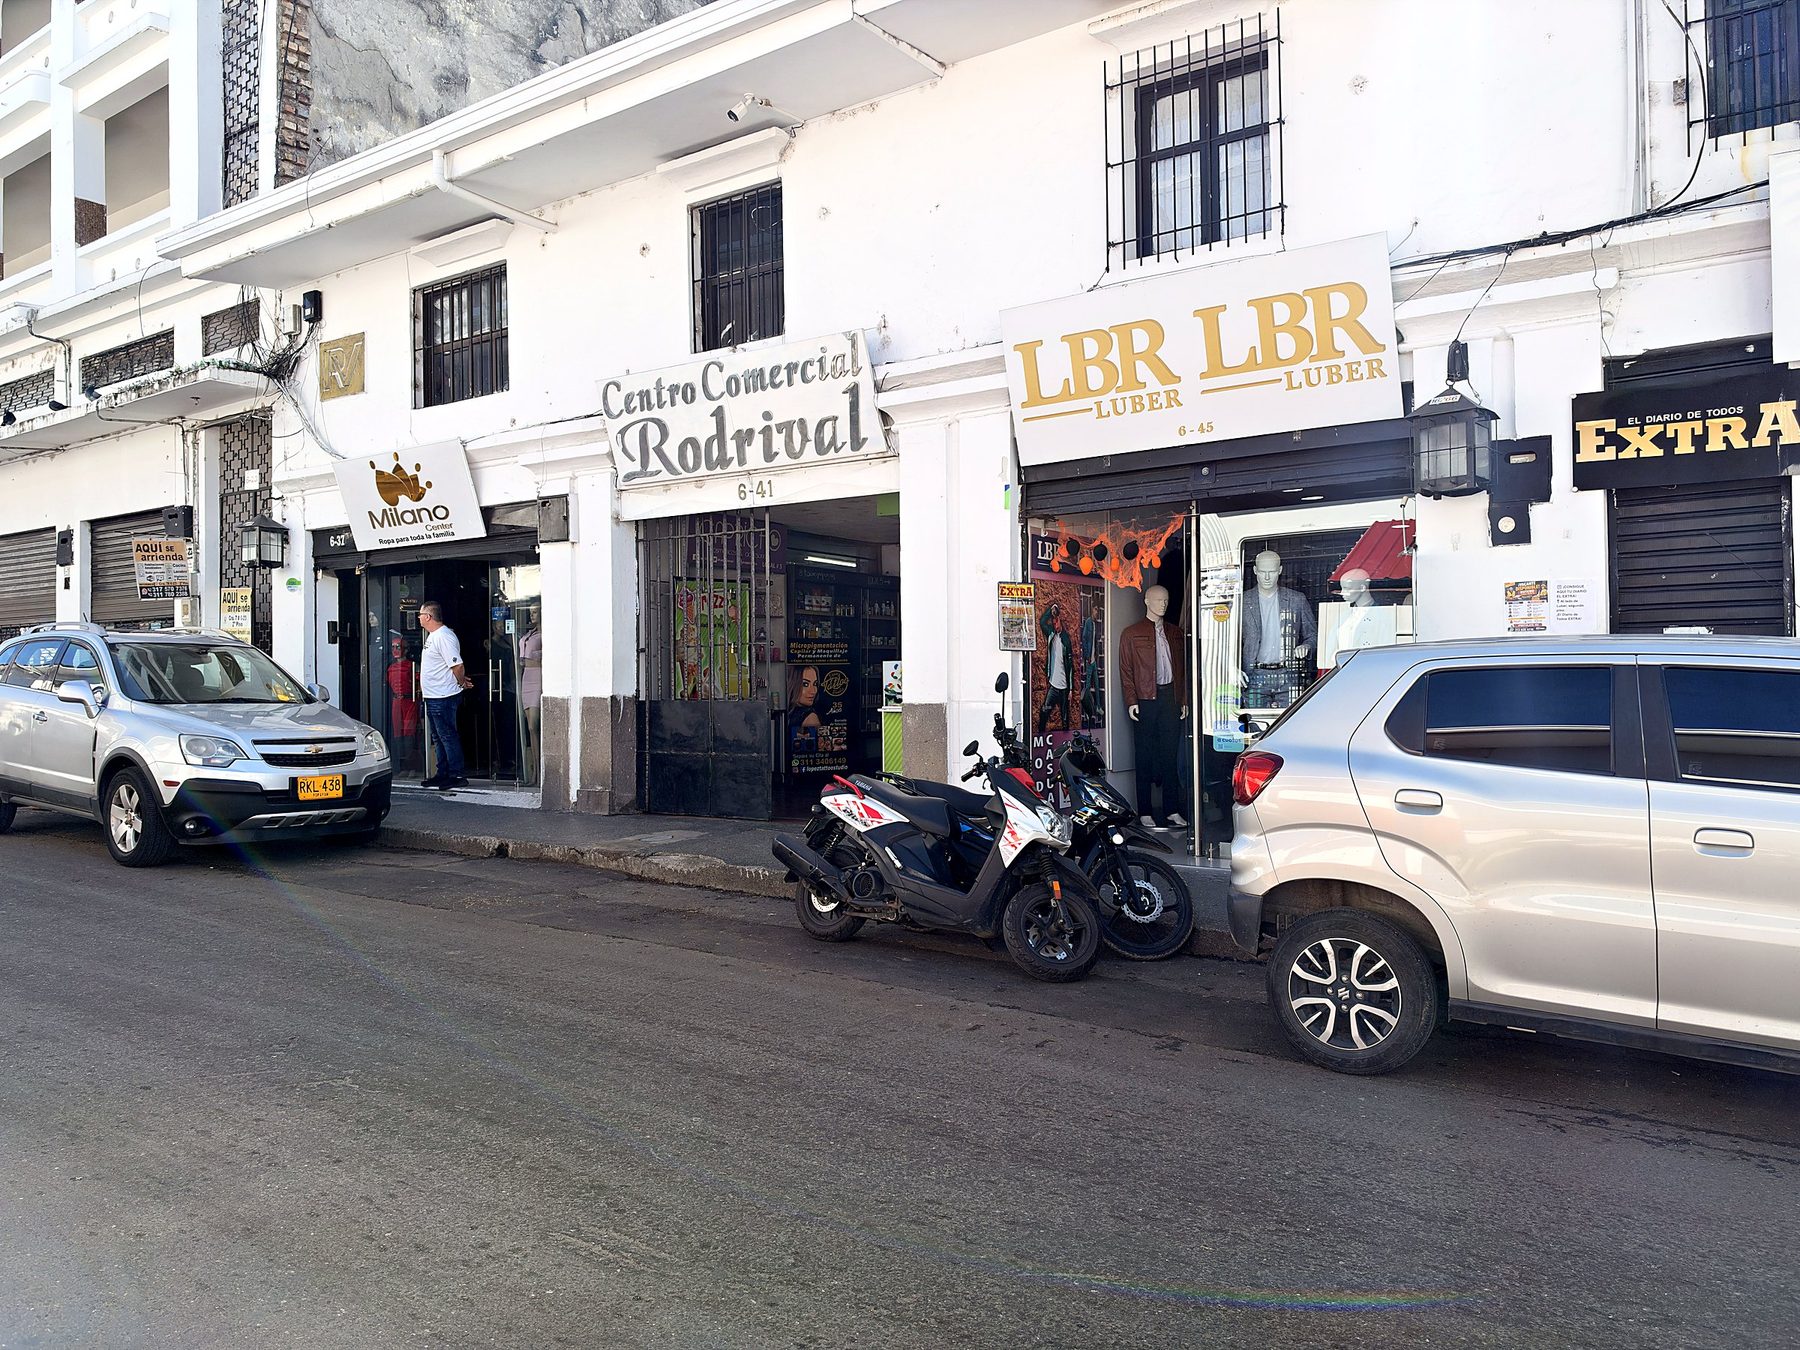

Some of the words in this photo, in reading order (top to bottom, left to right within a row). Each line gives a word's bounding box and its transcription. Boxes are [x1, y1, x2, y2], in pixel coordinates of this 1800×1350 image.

[1193, 281, 1387, 380] LBR
[1013, 318, 1182, 409] LBR
[1284, 358, 1388, 391] LUBER
[602, 378, 697, 420] Centro
[702, 331, 863, 401] Comercial
[1094, 389, 1183, 420] LUBER
[1627, 417, 1641, 425] EL
[1645, 412, 1683, 424] DIARIO
[1687, 411, 1702, 419] DE
[1706, 406, 1744, 417] TODOS
[615, 381, 869, 483] Rodrival
[1575, 400, 1800, 463] EXTRA
[737, 479, 774, 501] 6-41
[367, 504, 450, 529] Milano
[425, 522, 453, 532] Center
[136, 541, 163, 553] AQUÍ
[141, 553, 184, 561] arrienda
[240, 595, 248, 603] se
[1000, 586, 1033, 597] EXTRA
[300, 780, 319, 794] RKL
[322, 778, 341, 792] 438
[854, 780, 872, 792] YAMAHA
